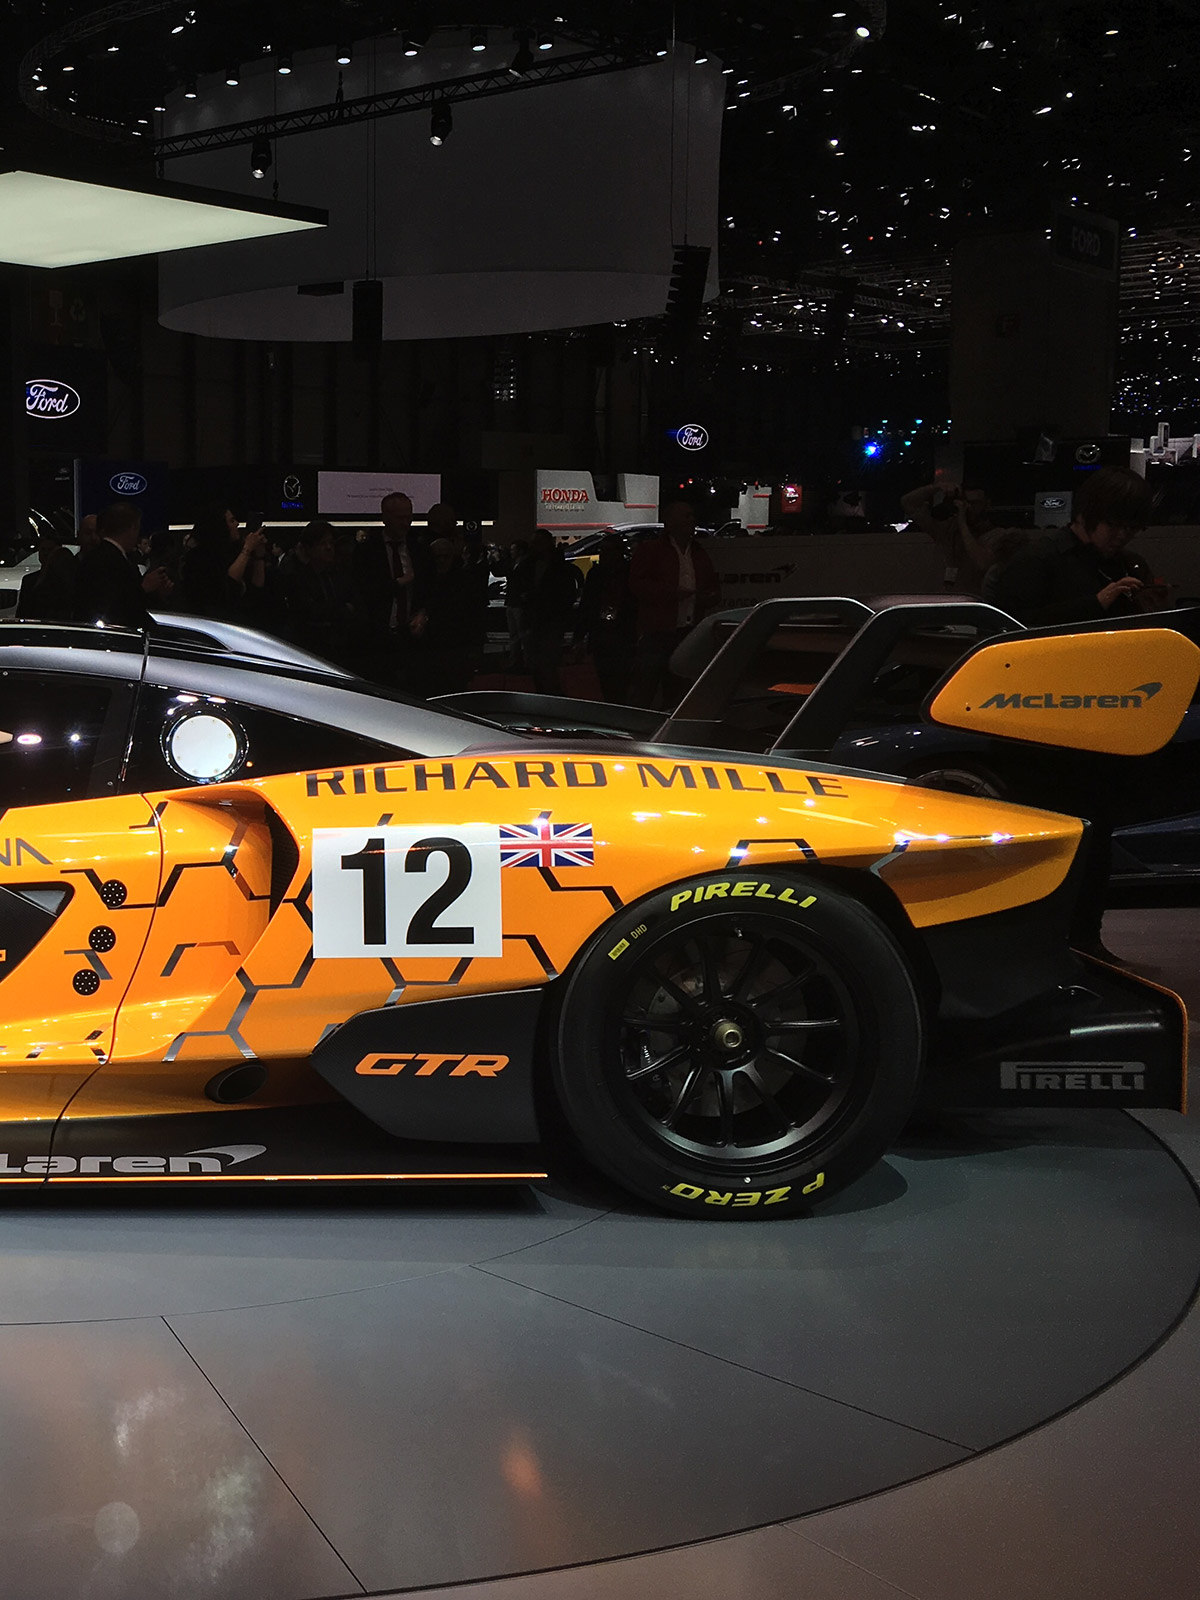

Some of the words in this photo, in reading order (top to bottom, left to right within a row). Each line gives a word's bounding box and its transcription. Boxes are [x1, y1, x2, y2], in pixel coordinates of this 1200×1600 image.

[26, 384, 69, 413] Ford
[682, 427, 704, 446] Ford
[117, 475, 141, 491] Ford
[541, 489, 590, 502] HONDA
[979, 692, 1143, 709] McLaren
[306, 759, 608, 798] RICHARD
[637, 763, 849, 798] MILLE
[341, 837, 476, 946] 12
[669, 881, 818, 912] PIRELLI
[630, 923, 649, 940] DHD
[355, 1052, 510, 1077] GTR
[1000, 1061, 1146, 1090] PIRELLI
[668, 1182, 794, 1208] ZERO
[802, 1171, 826, 1195] P
